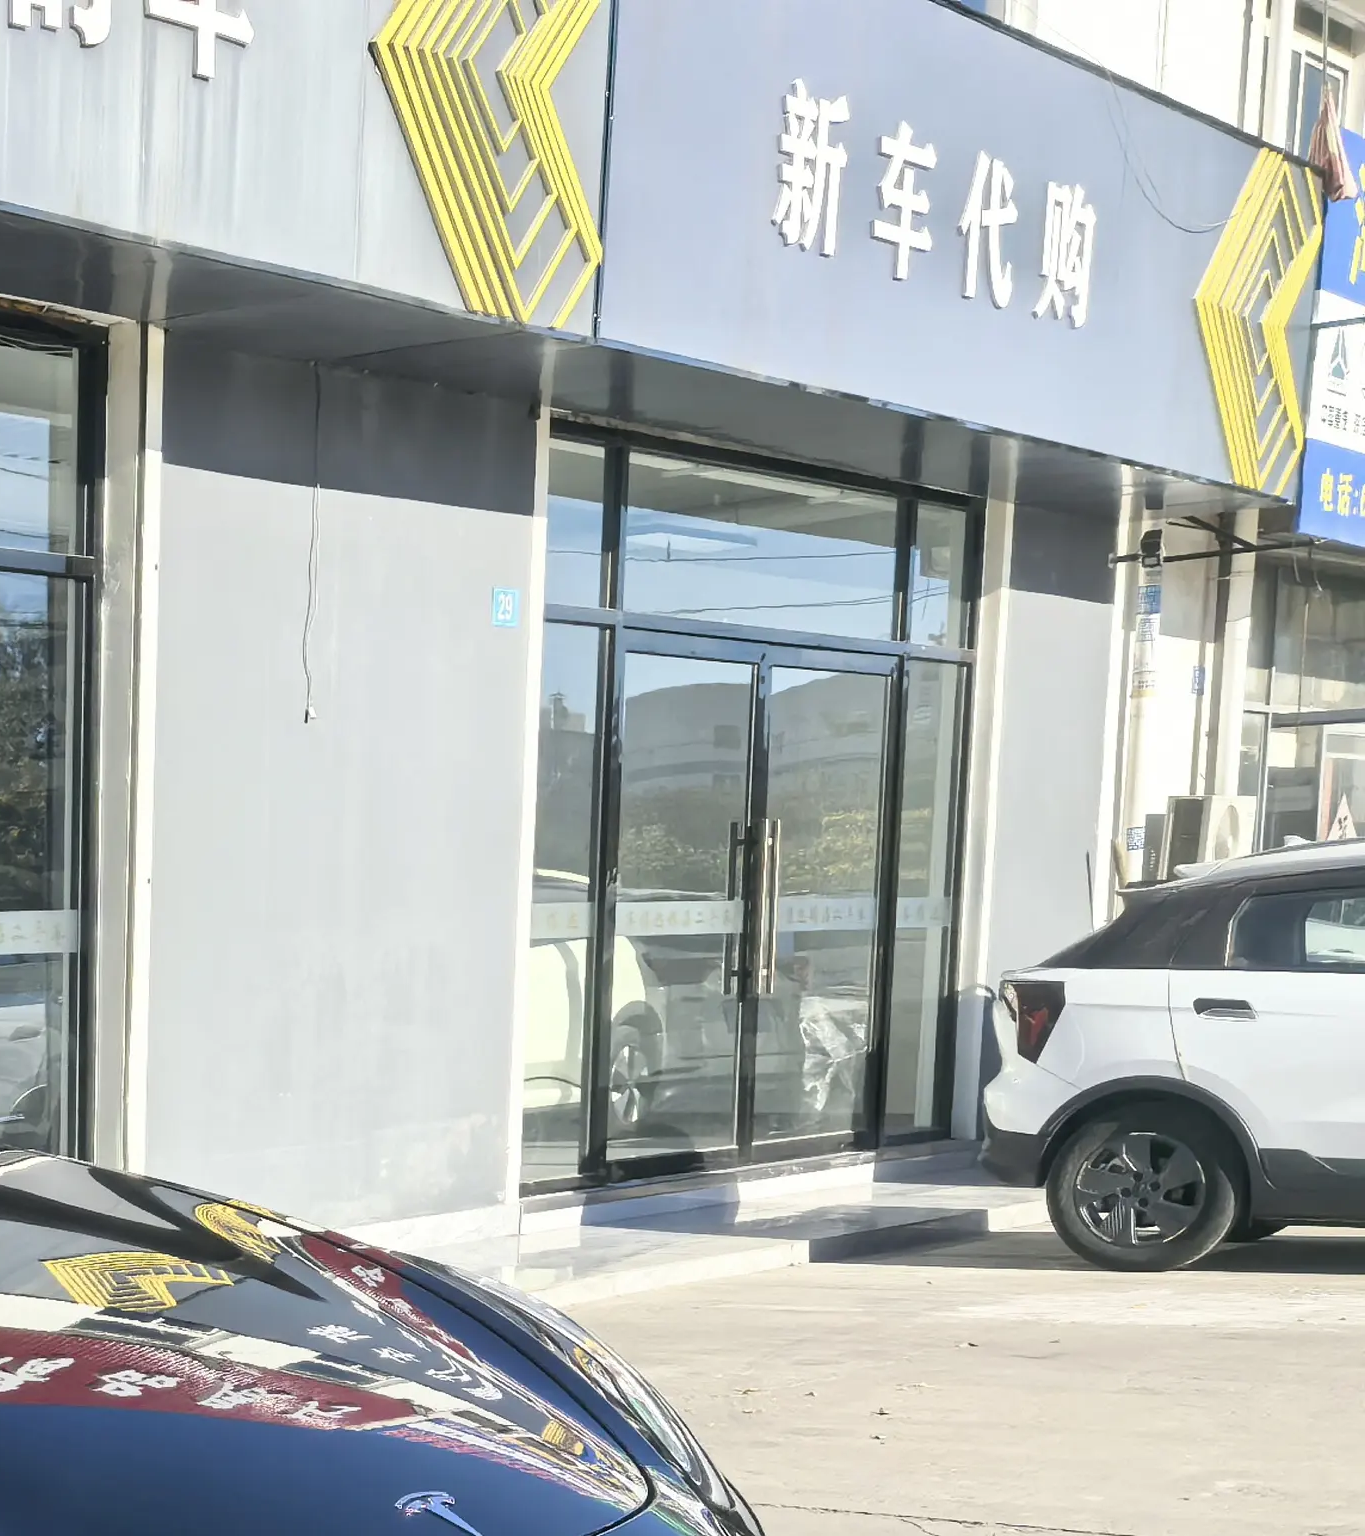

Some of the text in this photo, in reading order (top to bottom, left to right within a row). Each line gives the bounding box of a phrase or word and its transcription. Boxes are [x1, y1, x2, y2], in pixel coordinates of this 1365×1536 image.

[771, 77, 1097, 330] 新车代购
[497, 593, 513, 620] 29
